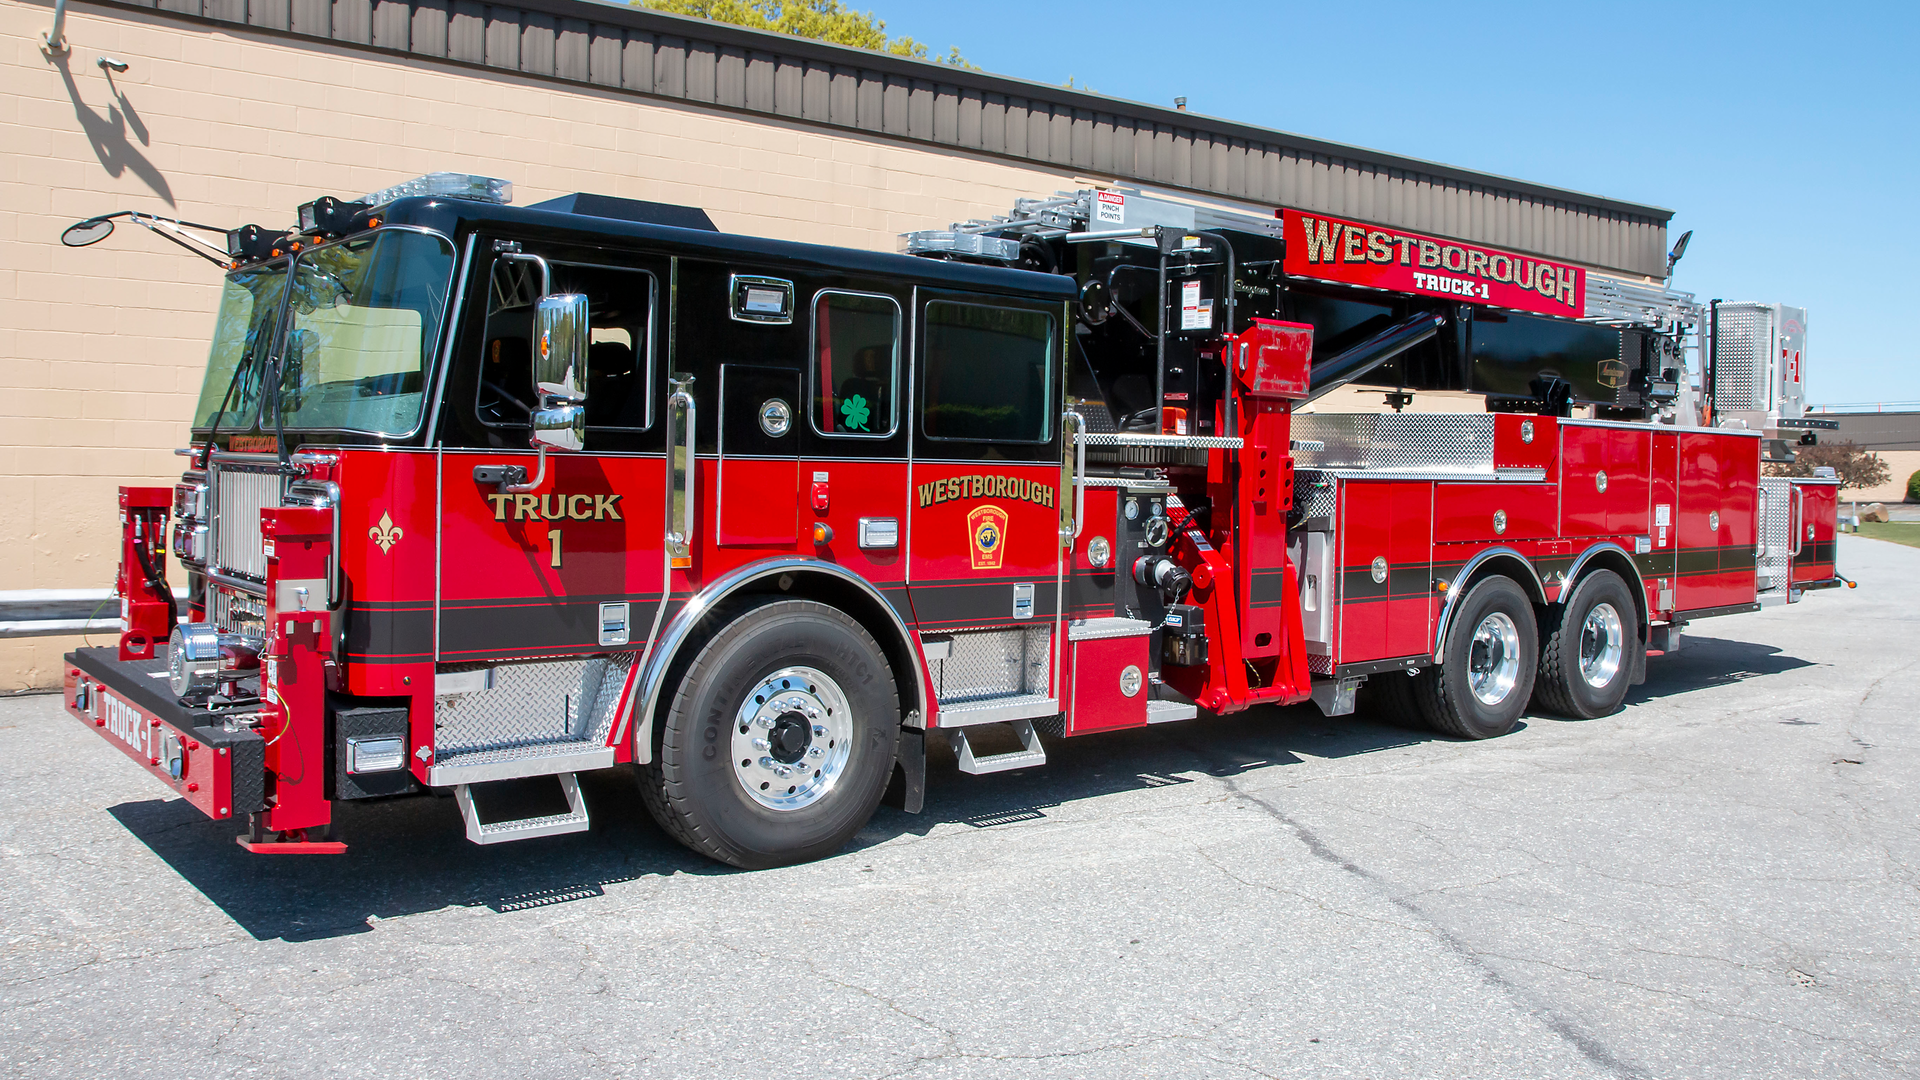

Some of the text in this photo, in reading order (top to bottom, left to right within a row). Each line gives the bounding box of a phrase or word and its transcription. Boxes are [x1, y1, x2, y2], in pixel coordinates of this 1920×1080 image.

[1102, 203, 1120, 212] PINCH
[1103, 195, 1123, 204] DANGER
[1100, 211, 1121, 220] POINTS
[1301, 216, 1577, 309] WESTBOROUGH
[1413, 272, 1490, 299] TRUCK-1
[228, 435, 278, 453] WESTBOROUG
[918, 475, 1054, 509] WESTBOROUGH
[488, 494, 623, 522] TRUCK
[971, 509, 1005, 520] WESTBOROUGH
[548, 529, 563, 569] 1
[103, 691, 152, 760] TRUCK-1
